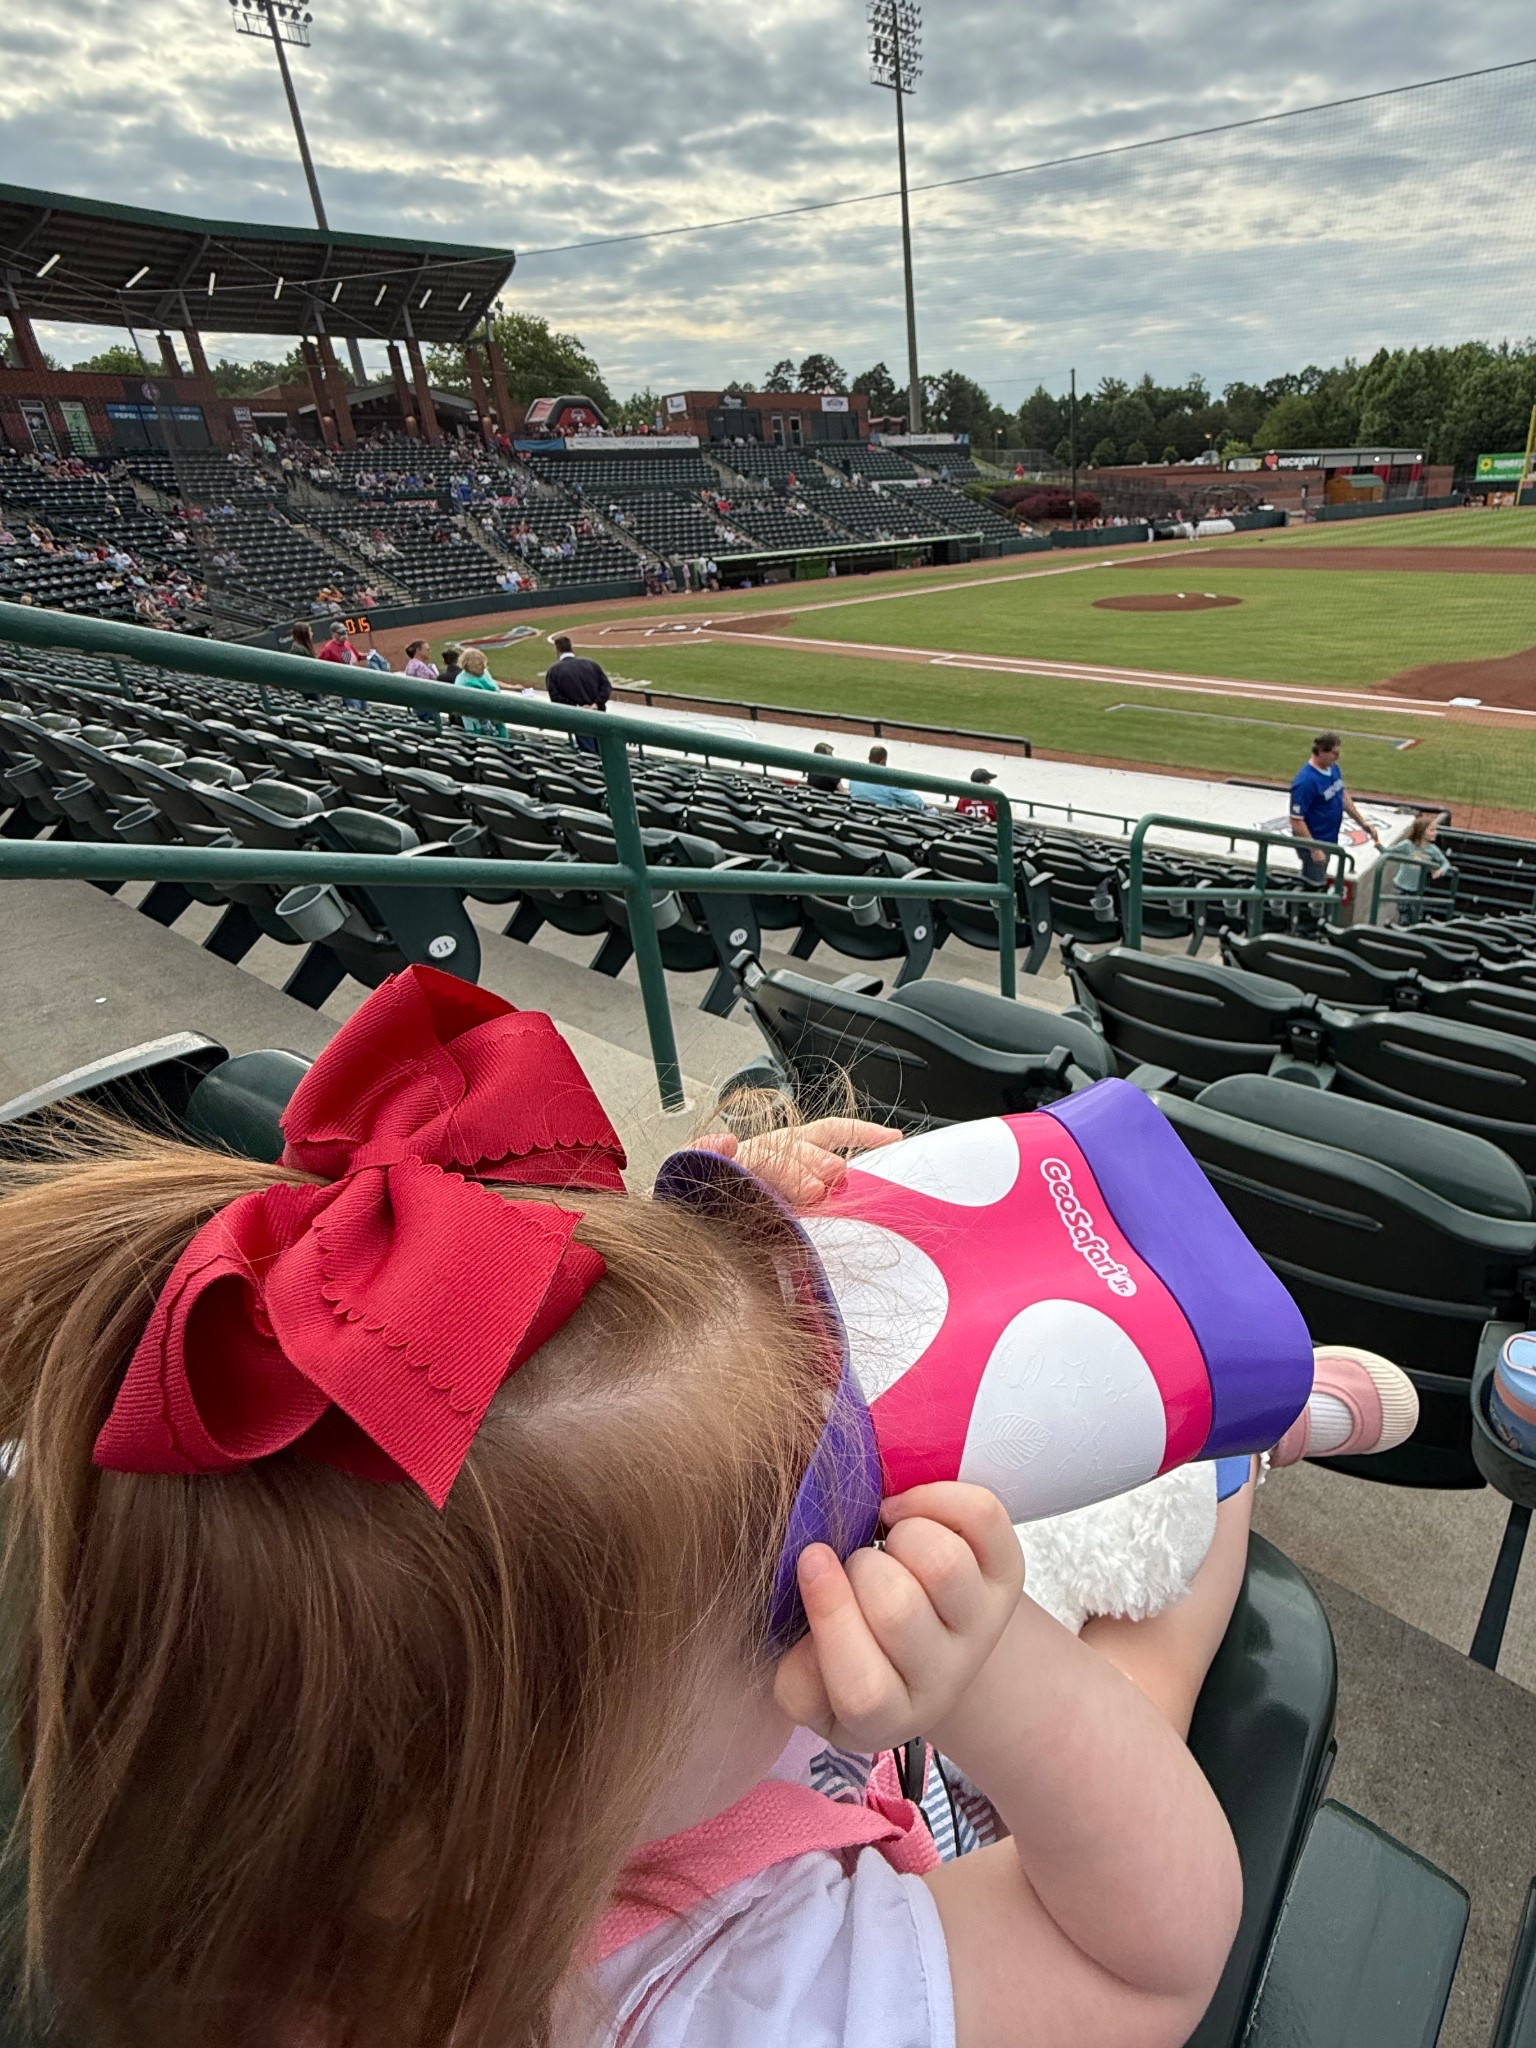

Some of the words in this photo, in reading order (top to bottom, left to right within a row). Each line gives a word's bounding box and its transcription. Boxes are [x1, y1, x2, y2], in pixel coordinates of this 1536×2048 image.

[1278, 456, 1320, 467] HICKORY
[437, 941, 450, 953] 11
[1041, 1158, 1126, 1278] GeoSafari
